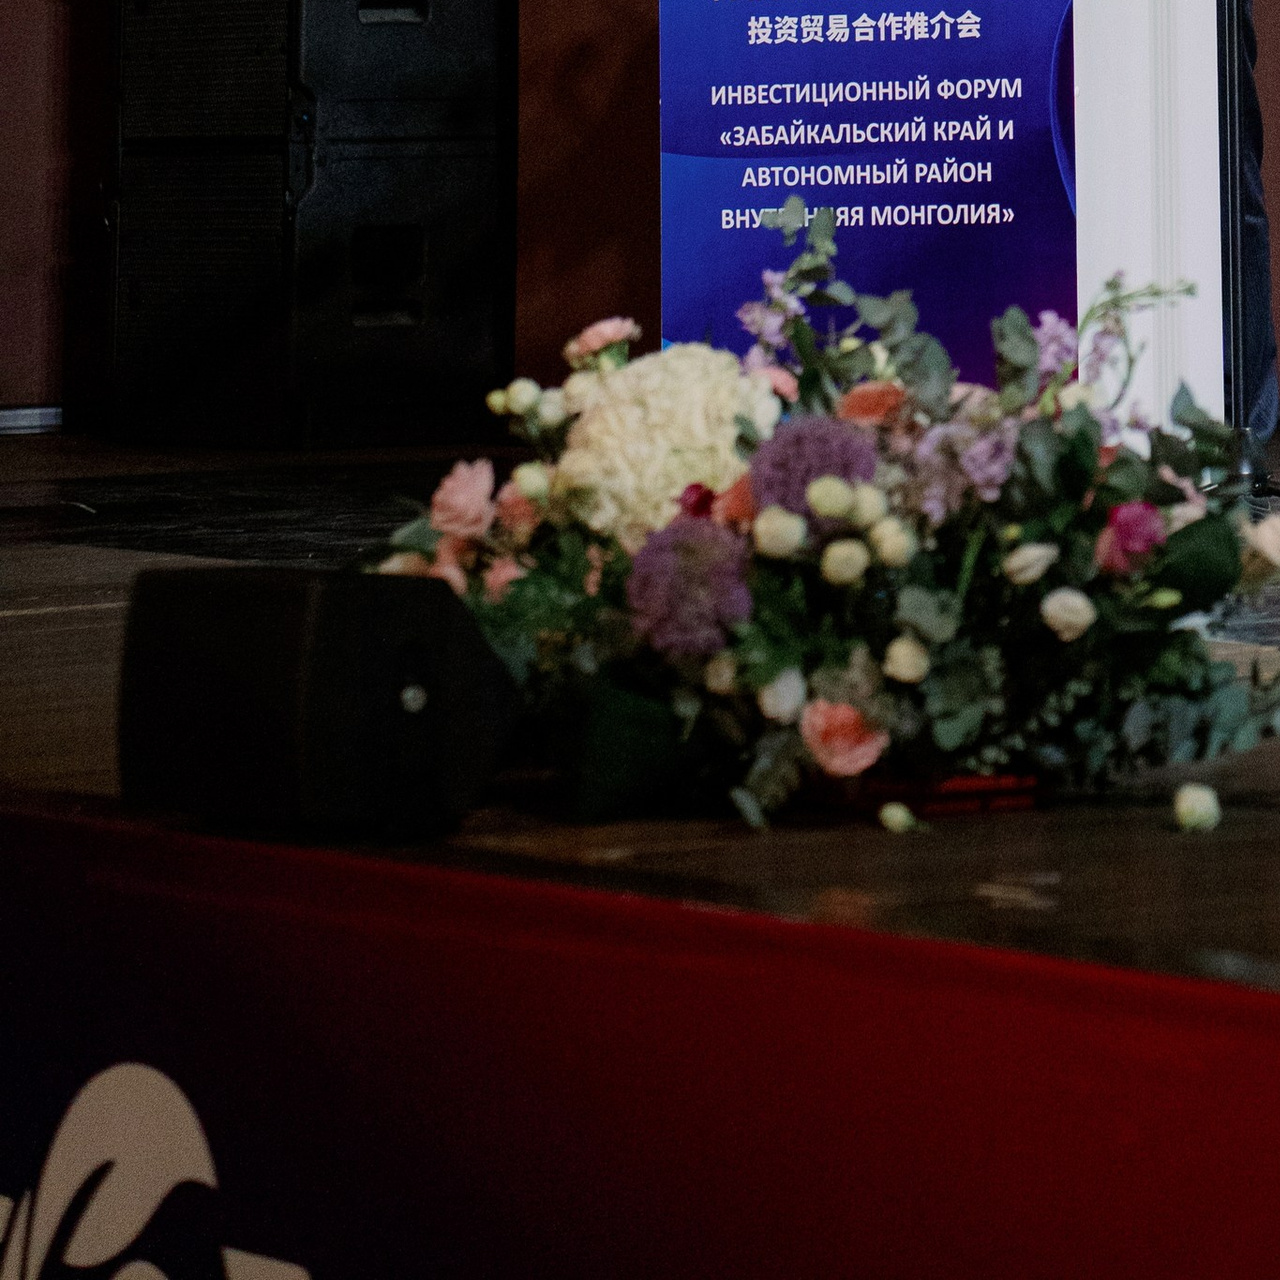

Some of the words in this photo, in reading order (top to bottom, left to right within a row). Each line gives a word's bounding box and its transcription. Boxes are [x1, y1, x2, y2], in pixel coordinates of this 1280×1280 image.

[747, 9, 982, 45] 投资贸易合作推介会
[711, 74, 930, 108] ИНВЕСТИЦИОННЫЙ
[936, 77, 1022, 100] ФОРУМ
[720, 116, 926, 147] «ЗАБАЙКАЛЬСКИЙ
[933, 114, 991, 142] КРАЙ
[998, 119, 1014, 140] И
[741, 158, 908, 187] АВТОНОМНЫЙ
[915, 157, 992, 184] РАЙОН
[721, 207, 864, 229] ВНУНЯЯ
[871, 203, 1015, 226] МОНГОЛИЯ»
